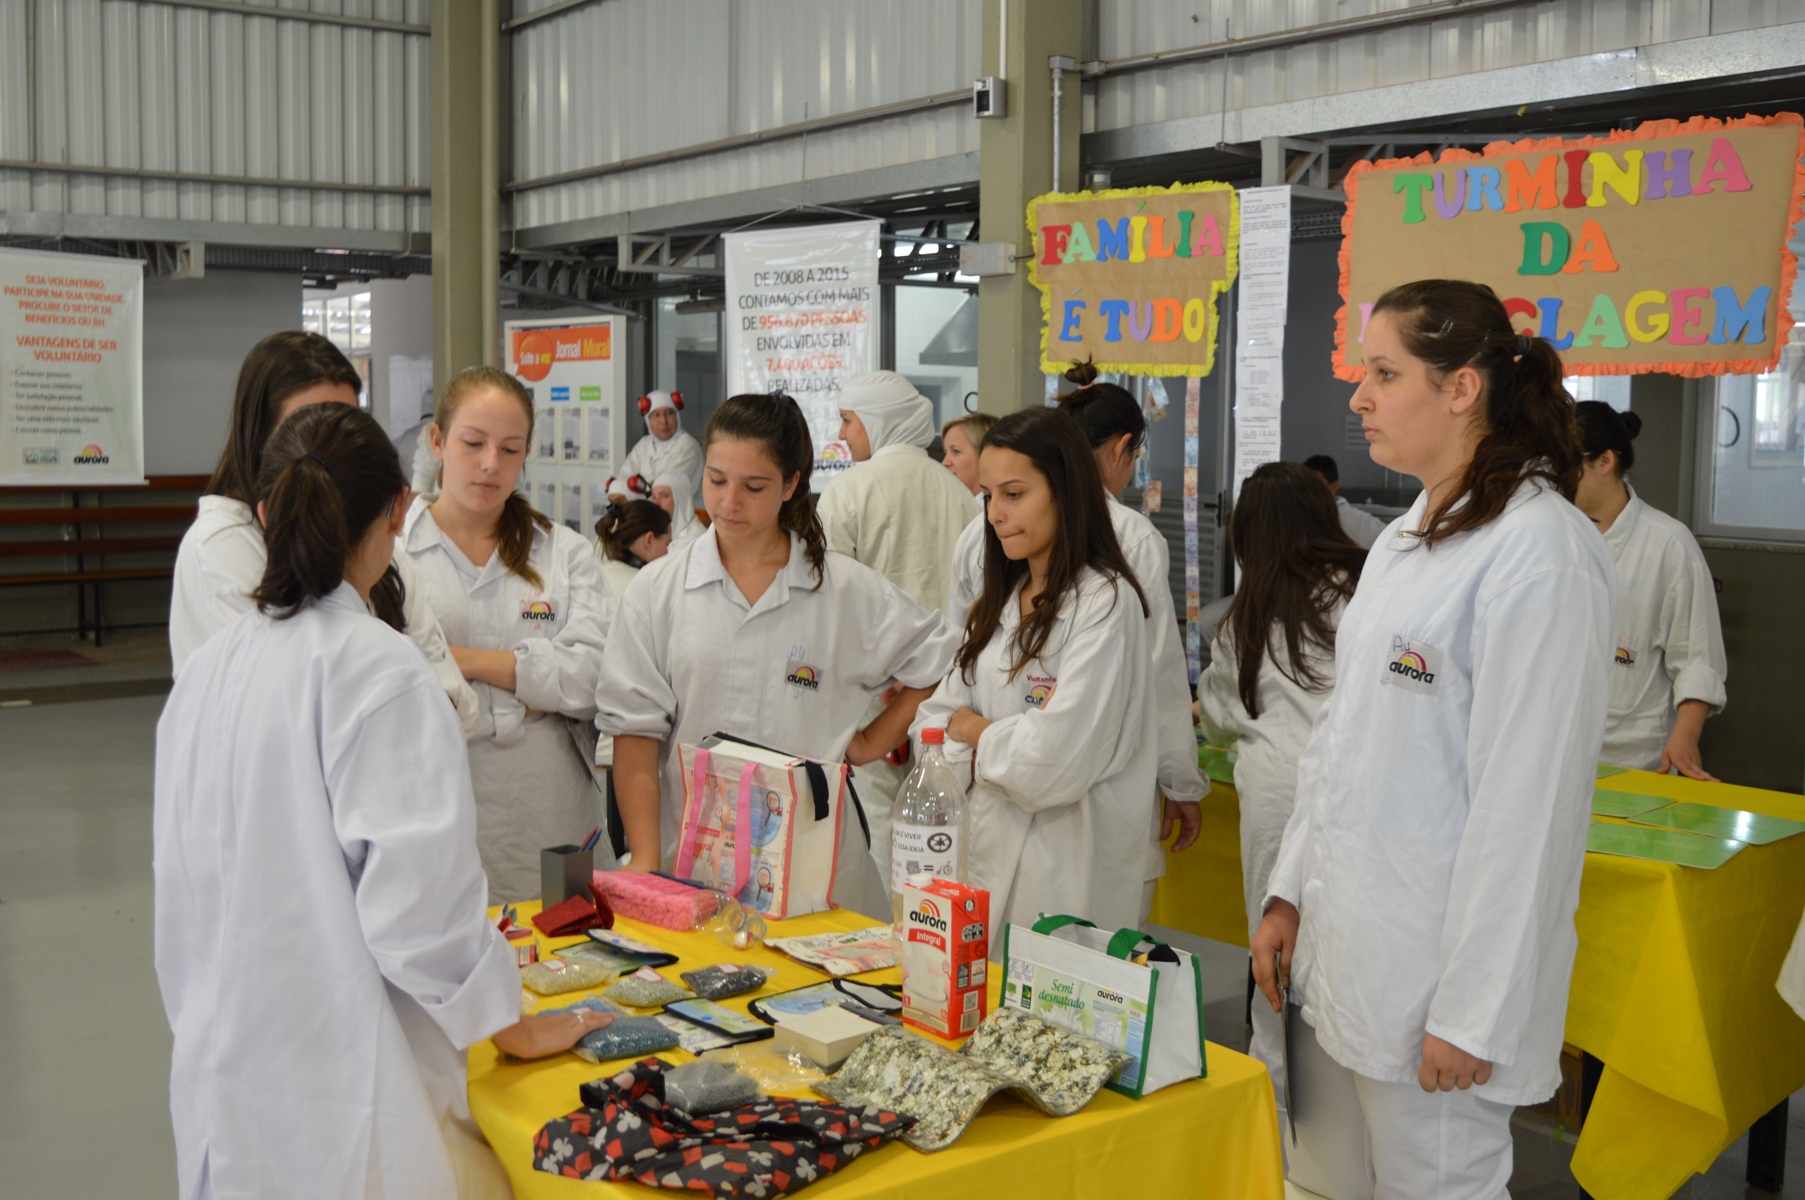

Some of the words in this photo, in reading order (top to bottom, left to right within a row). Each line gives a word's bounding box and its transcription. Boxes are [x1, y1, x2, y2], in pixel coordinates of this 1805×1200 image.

[1393, 137, 1752, 223] TURMINHA
[1041, 201, 1225, 265] FAMÍLIA
[1517, 219, 1619, 276] DA
[25, 274, 46, 284] SEJA
[754, 272, 770, 287] DE
[773, 270, 804, 286] 2008
[806, 269, 815, 283] A
[817, 267, 849, 282] 2015
[4, 285, 49, 297] PARTICIPE
[51, 289, 63, 299] NA
[66, 291, 84, 300] SUA
[739, 291, 804, 309] CONTAMOS
[806, 288, 836, 305] COM
[838, 286, 870, 302] MAIS
[19, 300, 60, 312] PROCURE
[63, 302, 71, 312] O
[72, 303, 99, 314] SETOR
[101, 305, 112, 315] DE
[1059, 288, 1086, 342] É
[1100, 298, 1205, 343] TUDO
[25, 313, 76, 325] BENEFÍCIOS
[78, 316, 91, 327] OU
[742, 316, 757, 331] DE
[811, 309, 867, 327] PESSOAS
[16, 335, 81, 349] VANTAGENS
[83, 339, 95, 350] DE
[98, 340, 117, 351] SER
[555, 339, 581, 359] Jornal
[583, 338, 611, 358] Mural
[756, 333, 830, 351] ENVOLVIDAS
[832, 332, 851, 347] EM
[34, 349, 102, 364] VOLUNTÁRIO
[535, 353, 540, 365] a
[801, 352, 842, 375] AÇÕES
[768, 377, 842, 393] REALIZADAS.
[74, 454, 109, 465] aurora
[522, 611, 555, 621] aurora
[1389, 661, 1435, 684] aurora
[787, 674, 819, 689] aurora
[903, 832, 921, 840] VIVER
[898, 843, 909, 851] ESSA
[909, 845, 924, 853] IDEIA
[909, 910, 947, 932] aurora
[916, 930, 941, 947] Integral
[1051, 979, 1074, 995] Semi
[1038, 990, 1085, 1010] desnatado
[1097, 989, 1123, 1004] aurora
